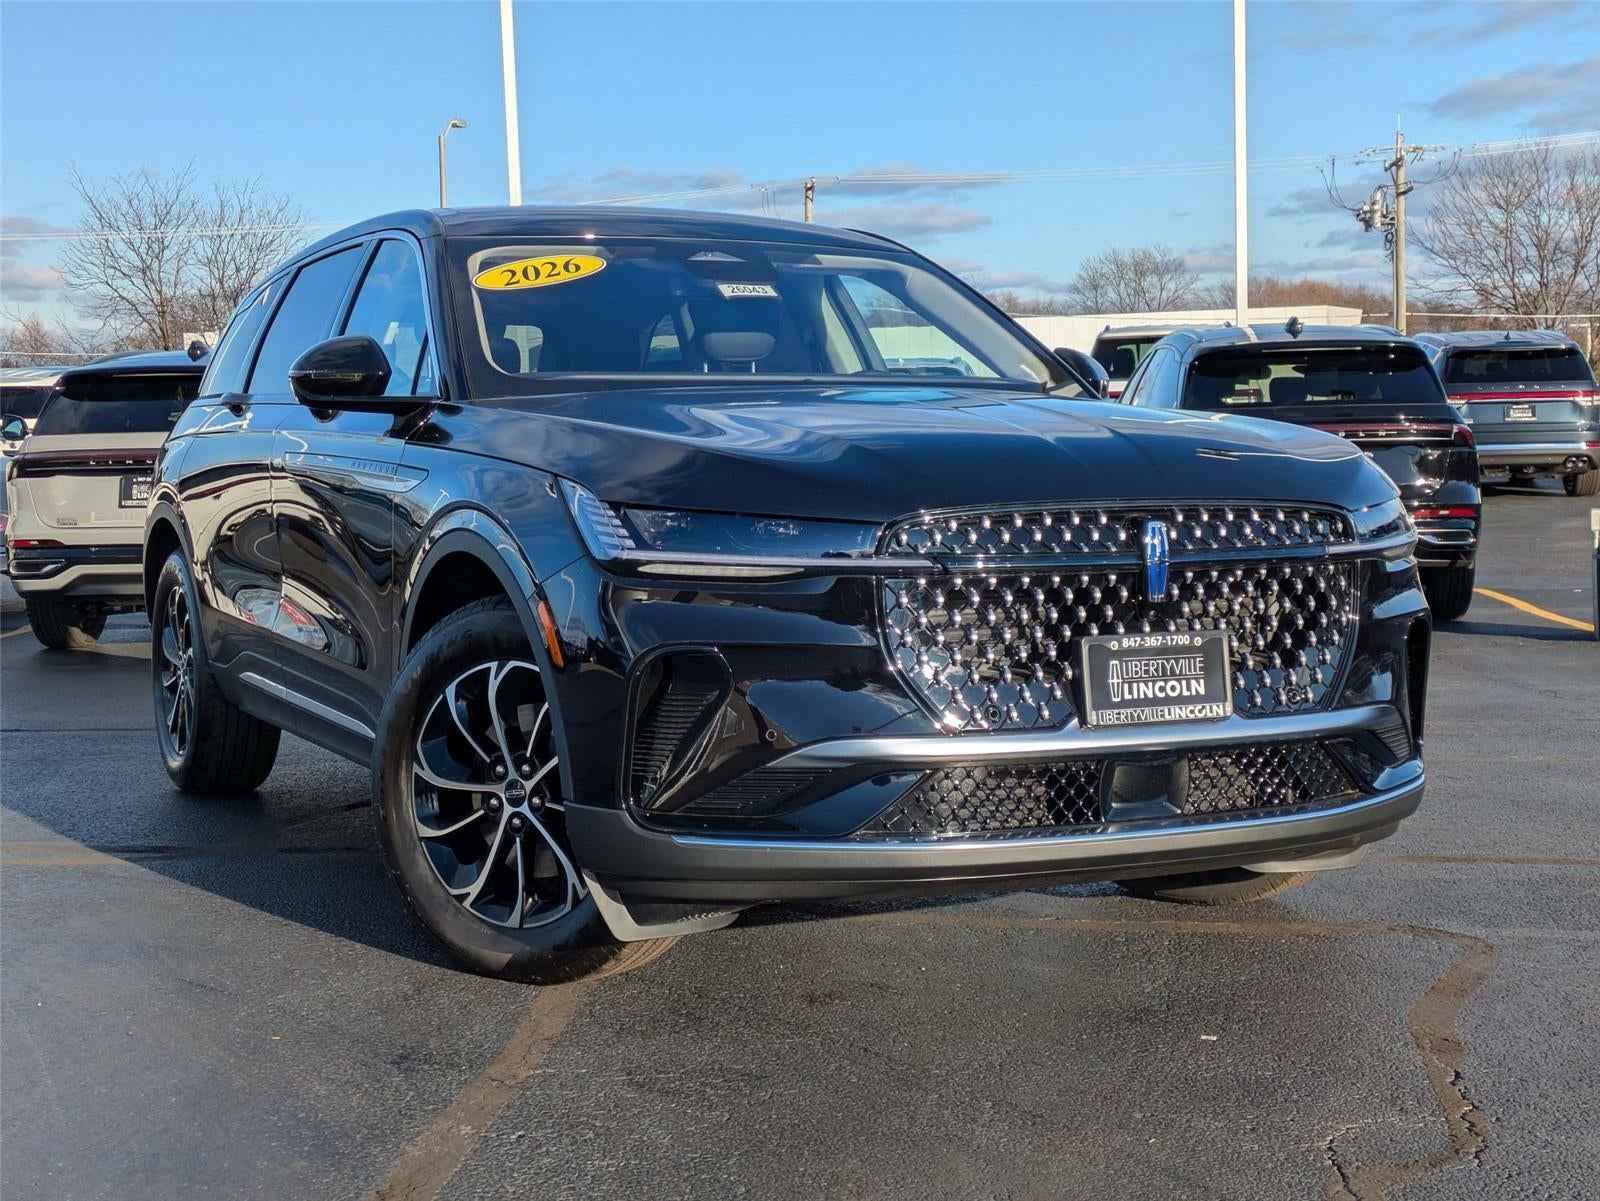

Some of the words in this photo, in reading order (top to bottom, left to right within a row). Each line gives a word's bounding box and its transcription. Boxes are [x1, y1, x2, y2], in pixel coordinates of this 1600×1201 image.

[501, 257, 581, 286] 2026
[728, 285, 768, 295] 26043
[1122, 635, 1190, 648] 847-367-1700
[1122, 658, 1205, 679] LIBERTYVILLE
[1124, 679, 1206, 700] LINCOLN
